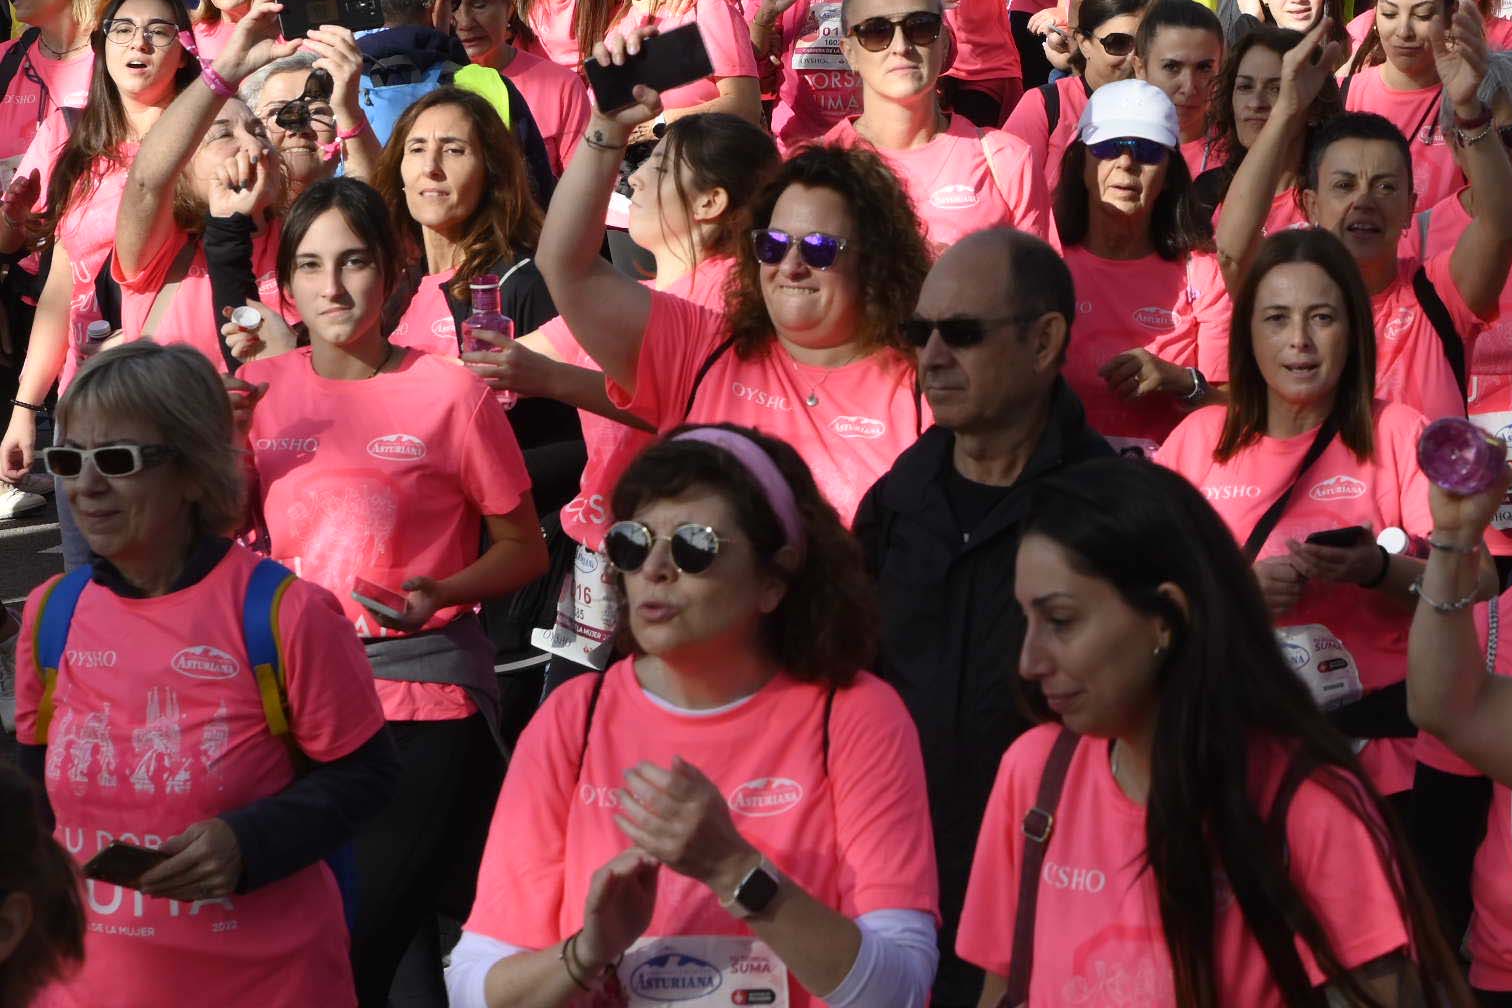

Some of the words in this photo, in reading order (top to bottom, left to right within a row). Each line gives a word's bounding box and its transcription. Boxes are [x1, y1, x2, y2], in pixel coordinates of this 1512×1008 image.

[256, 438, 319, 453] OYSHO
[735, 789, 801, 807] ASTURIANA
[637, 972, 716, 991] ASTURIANA
